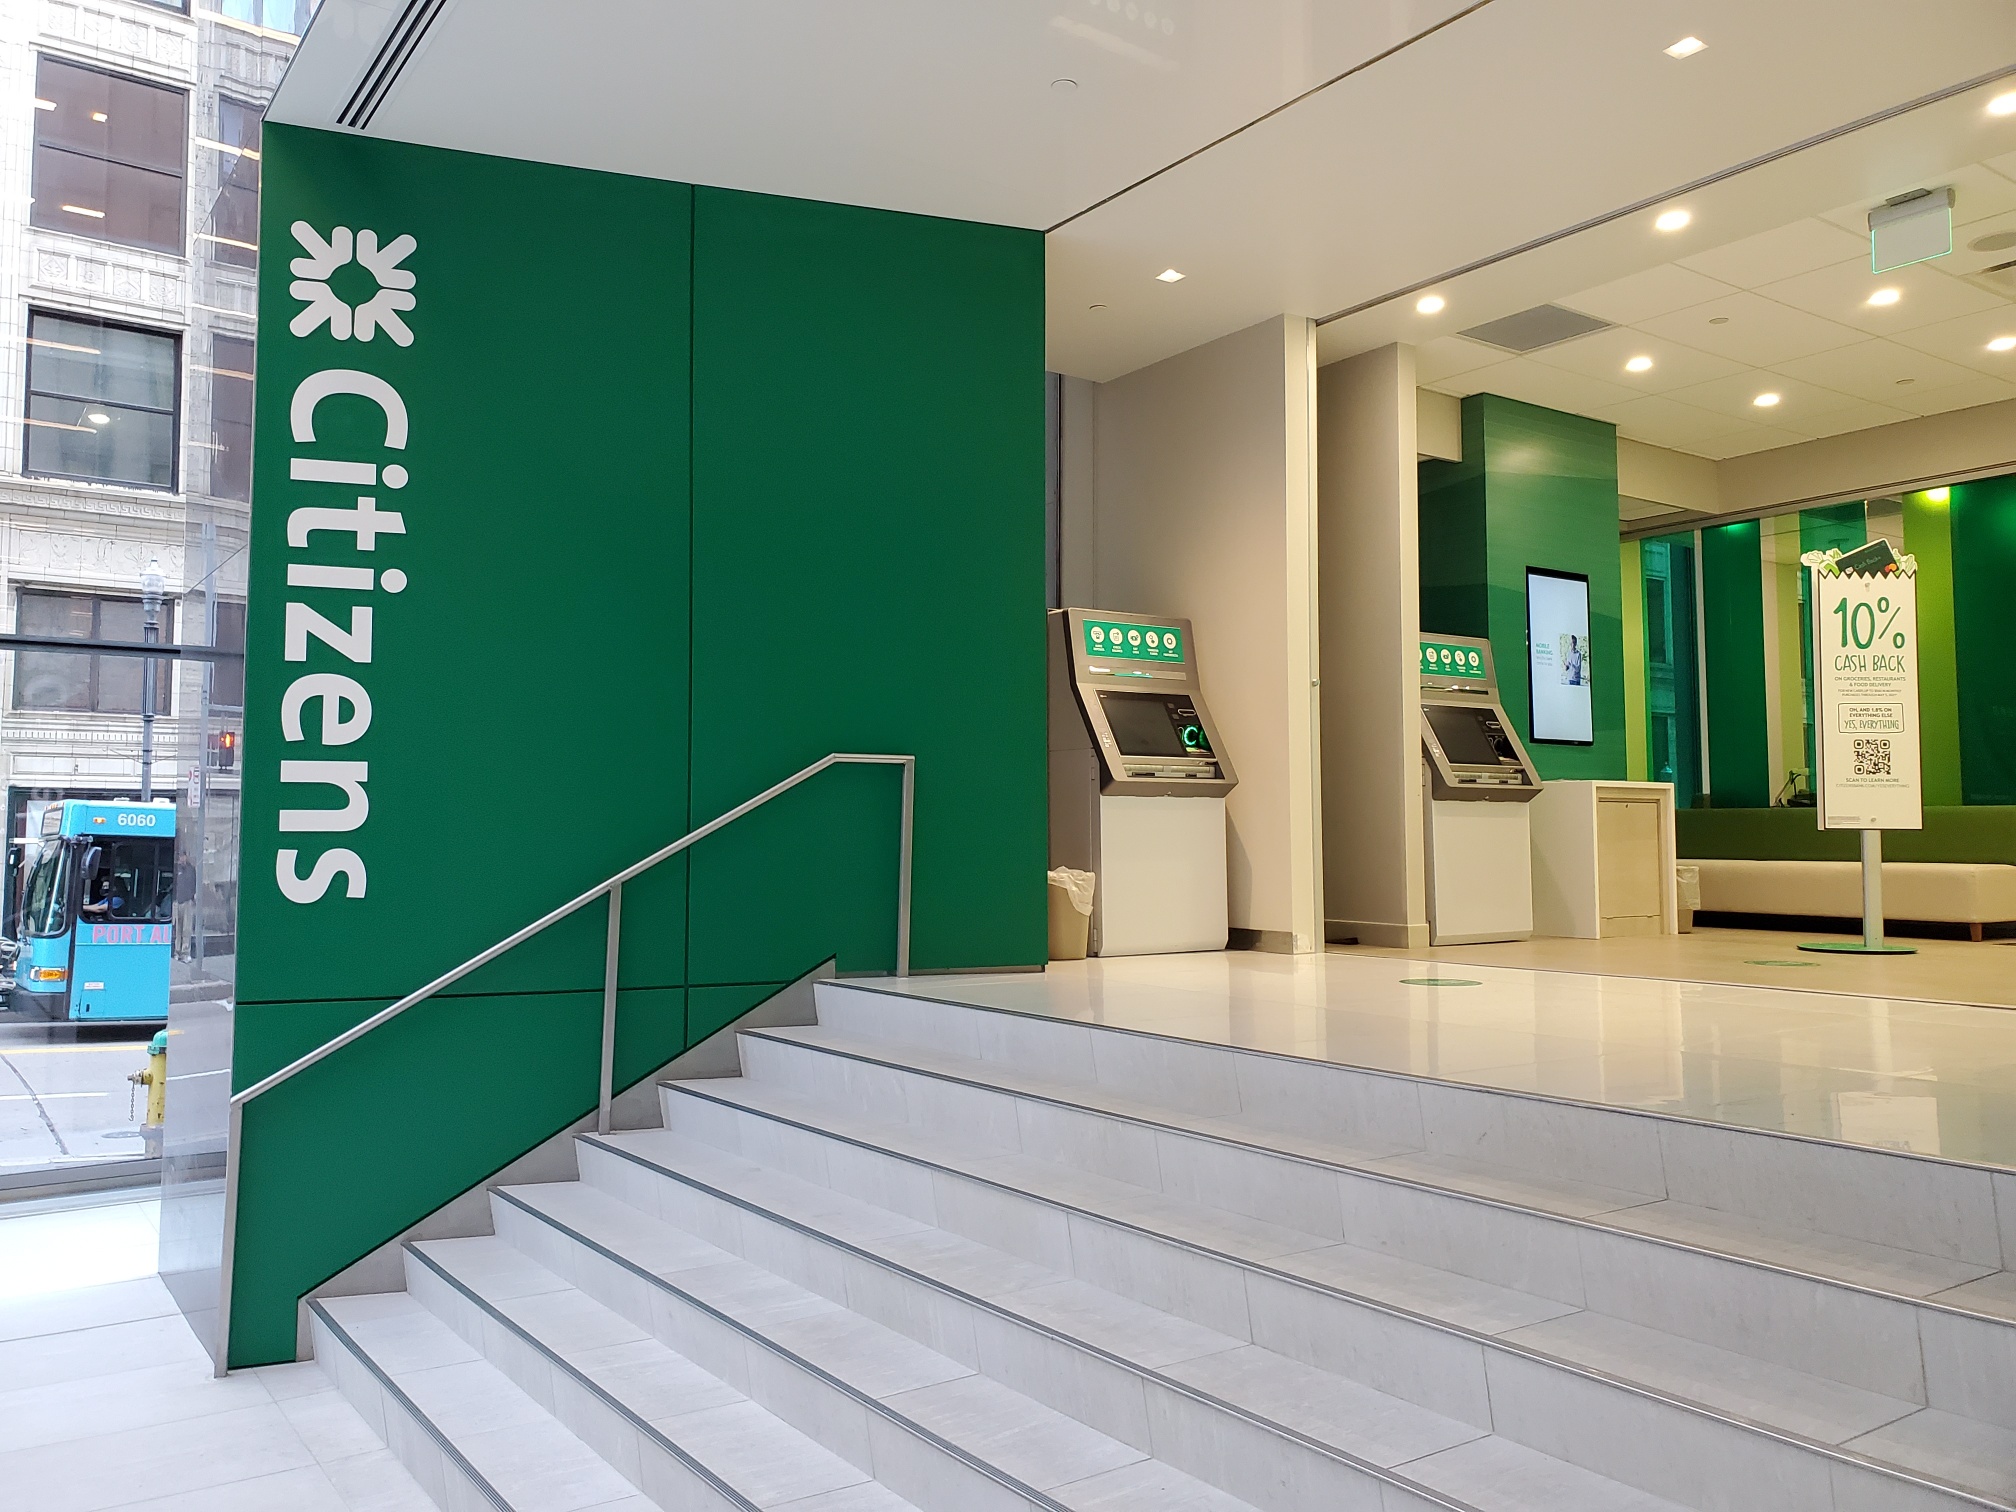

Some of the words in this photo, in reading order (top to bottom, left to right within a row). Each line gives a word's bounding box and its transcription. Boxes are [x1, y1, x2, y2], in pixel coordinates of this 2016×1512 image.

[1833, 596, 1906, 650] 10%
[275, 368, 409, 904] Citizens
[1834, 653, 1867, 673] CASH
[1872, 653, 1906, 673] BACK
[1844, 719, 1858, 731] YES,
[1859, 719, 1900, 730] EVERYTHING
[117, 813, 156, 827] 6060
[92, 924, 146, 944] PORT
